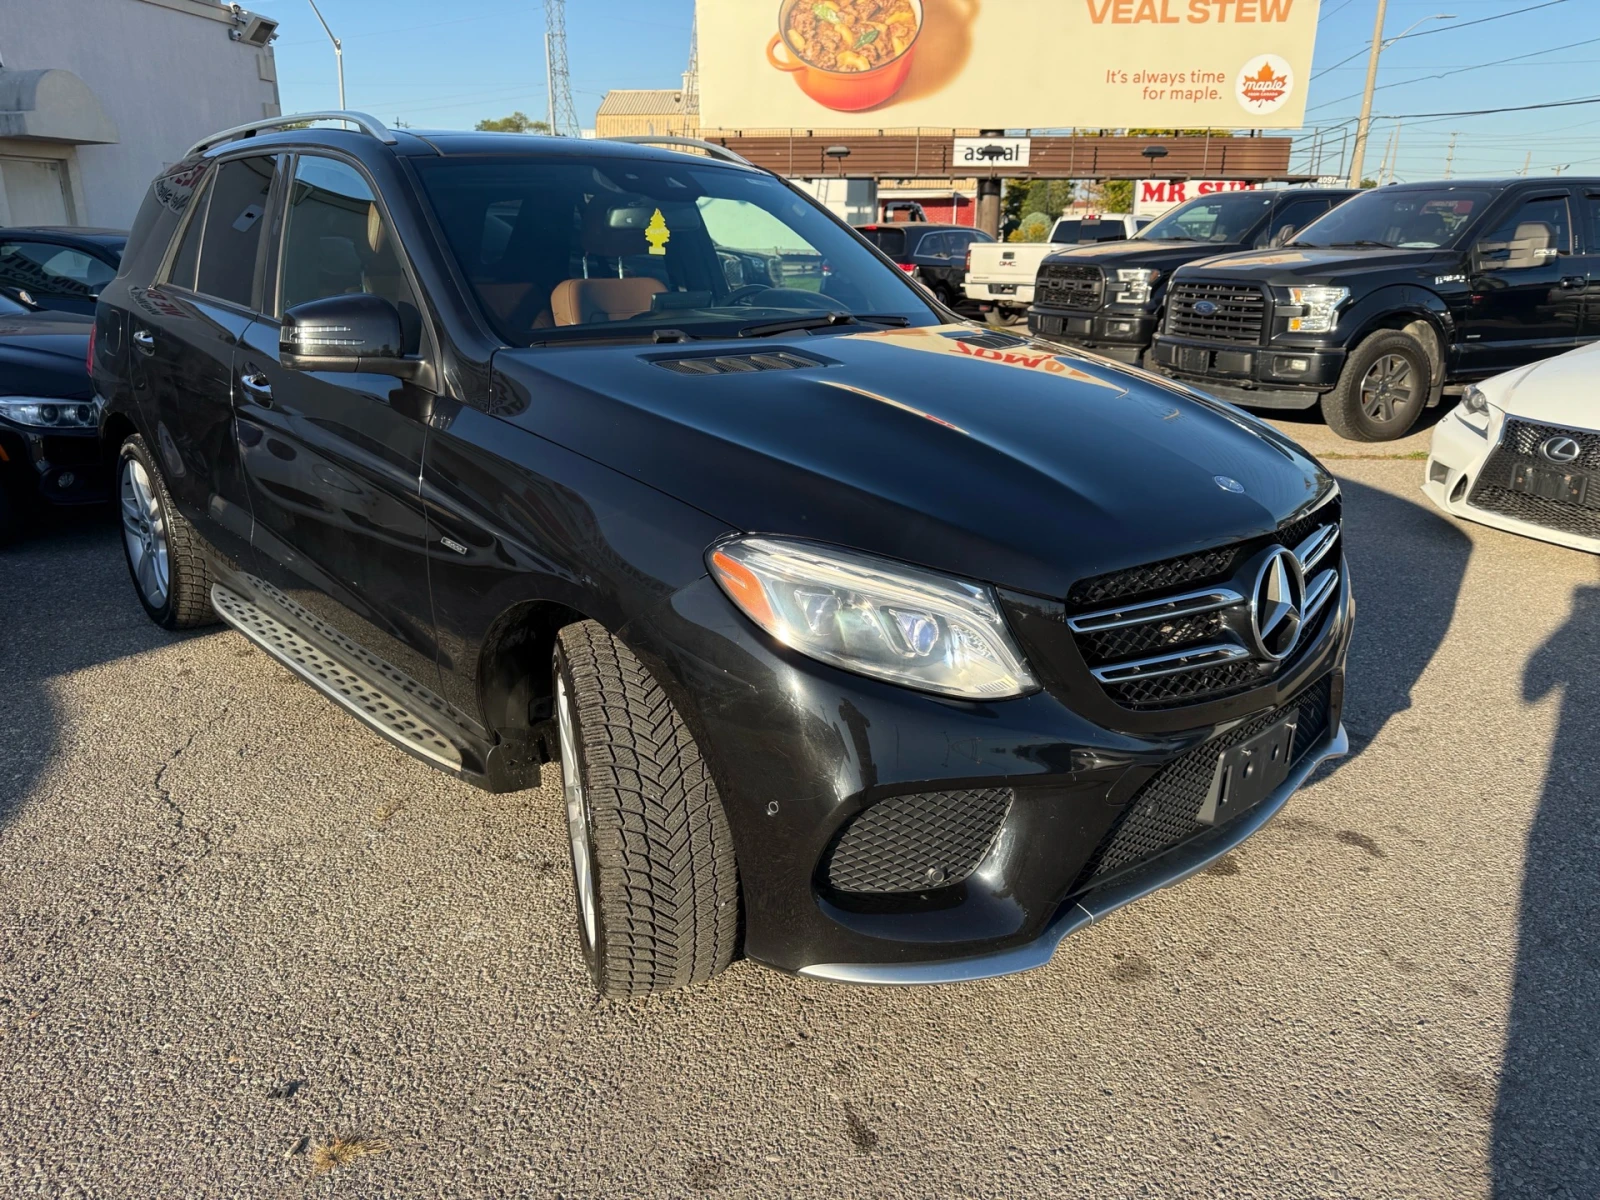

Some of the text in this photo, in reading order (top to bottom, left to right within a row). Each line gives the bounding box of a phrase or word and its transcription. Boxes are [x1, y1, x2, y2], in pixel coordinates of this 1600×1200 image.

[1087, 0, 1294, 24] VEAL STEW
[1106, 69, 1226, 87] It's always time
[1243, 79, 1284, 92] maple
[1143, 86, 1223, 103] for maple.
[964, 144, 1019, 161] asal
[1141, 182, 1186, 203] MR
